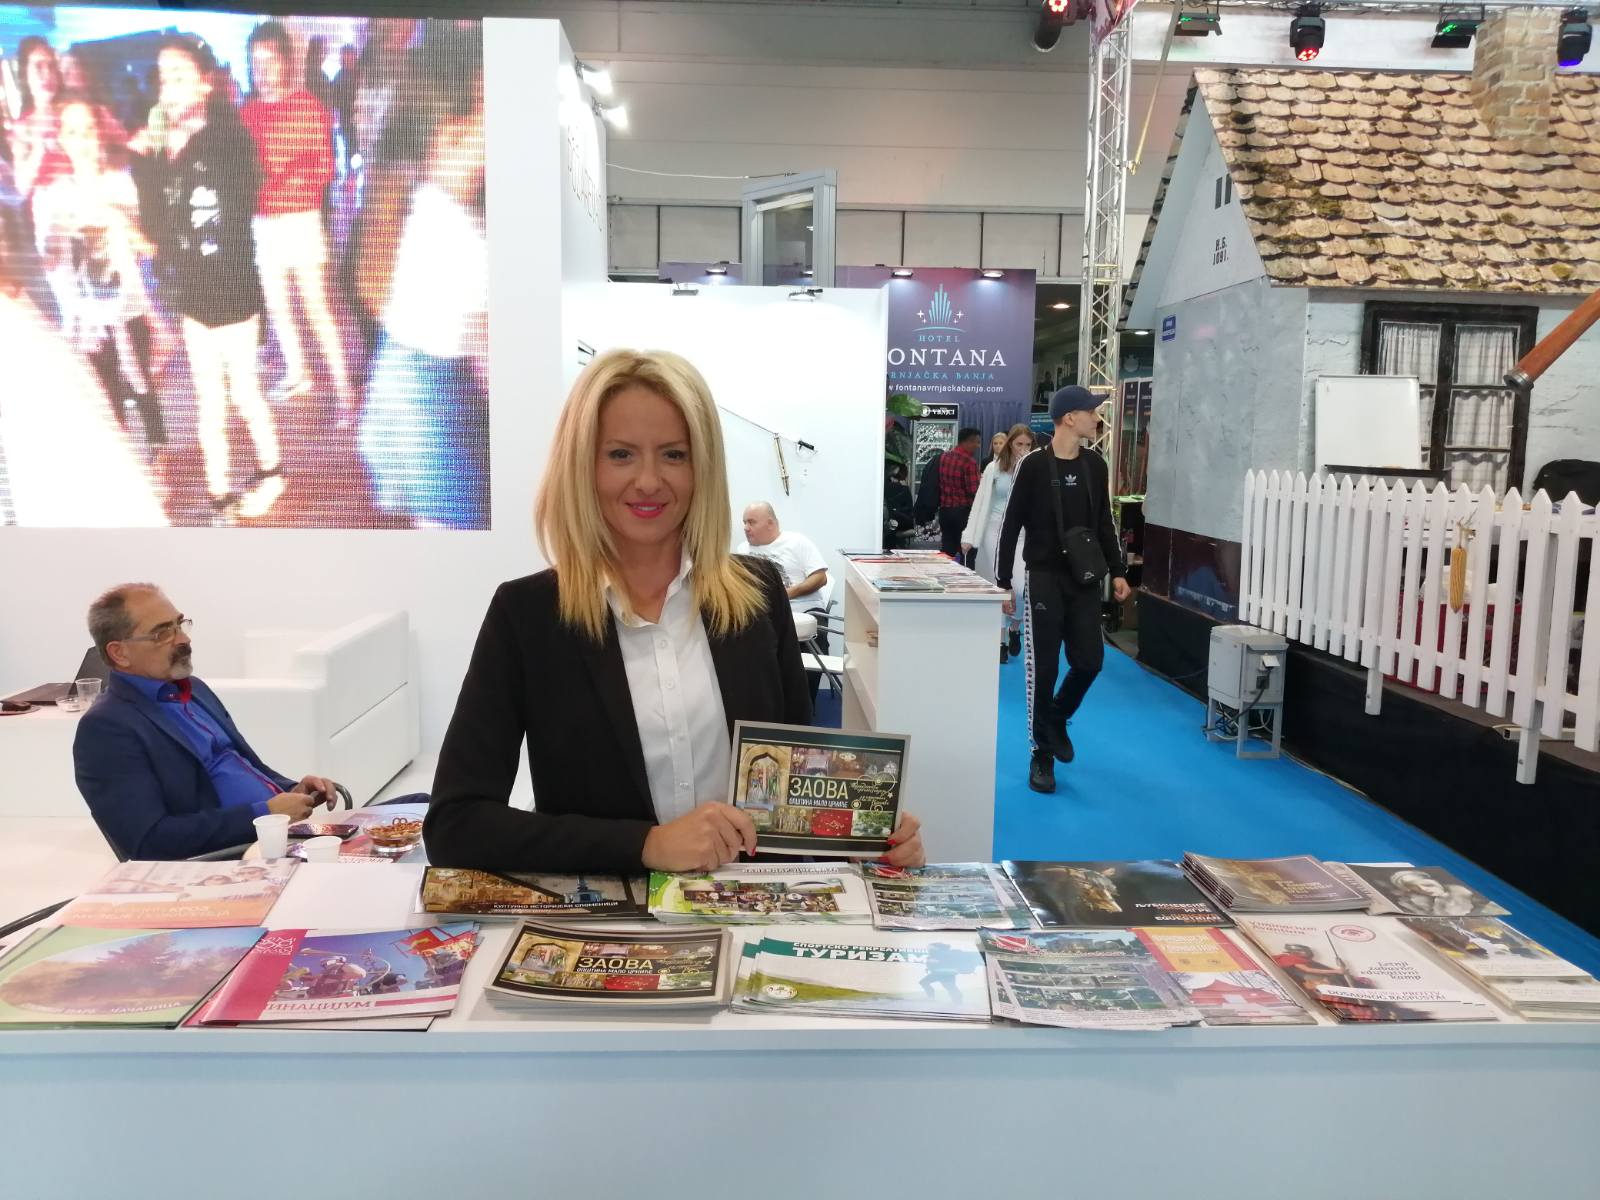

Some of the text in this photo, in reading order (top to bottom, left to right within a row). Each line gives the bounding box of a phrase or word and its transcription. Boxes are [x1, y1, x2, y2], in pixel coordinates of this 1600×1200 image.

[887, 348, 1007, 367] ONTANA
[789, 777, 849, 800] ЗАОВА
[793, 942, 849, 950] СПОРТСКО
[792, 947, 929, 963] ТУРИЗАМ
[578, 957, 653, 970] ЗАОВА
